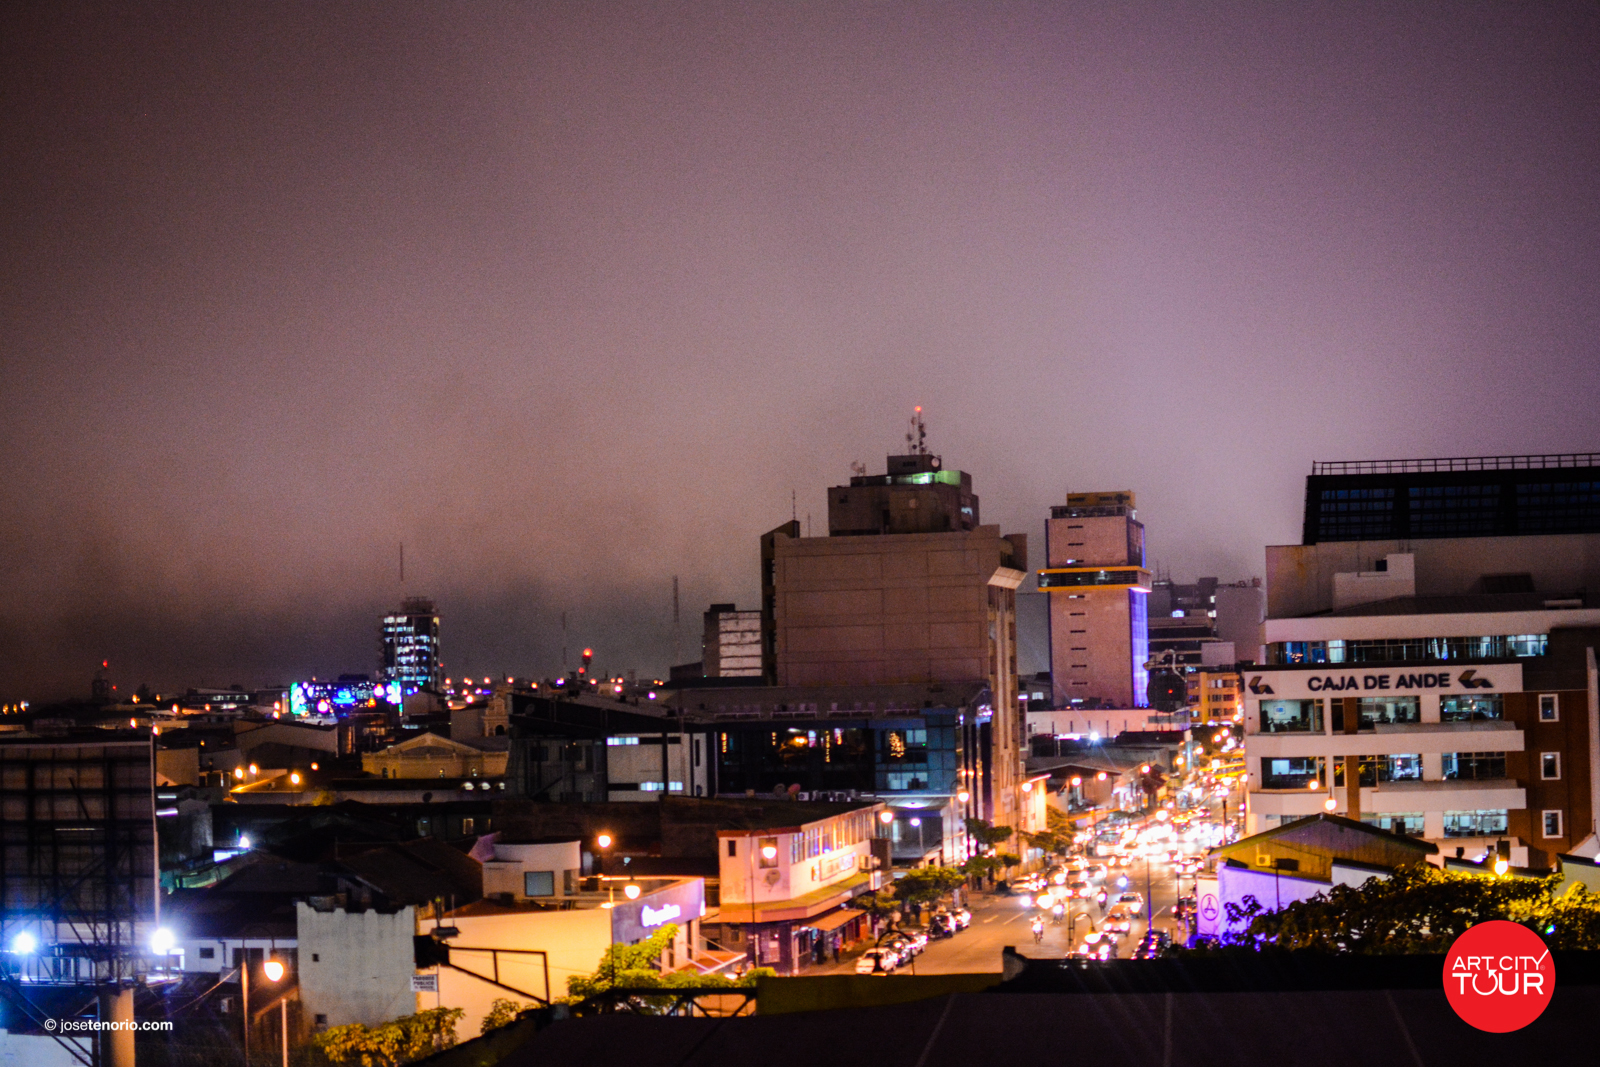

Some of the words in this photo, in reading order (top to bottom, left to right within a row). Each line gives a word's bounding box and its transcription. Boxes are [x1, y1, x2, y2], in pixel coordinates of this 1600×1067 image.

[1307, 676, 1359, 691] CAJA
[1363, 675, 1391, 690] DE
[1395, 672, 1451, 689] ANDE
